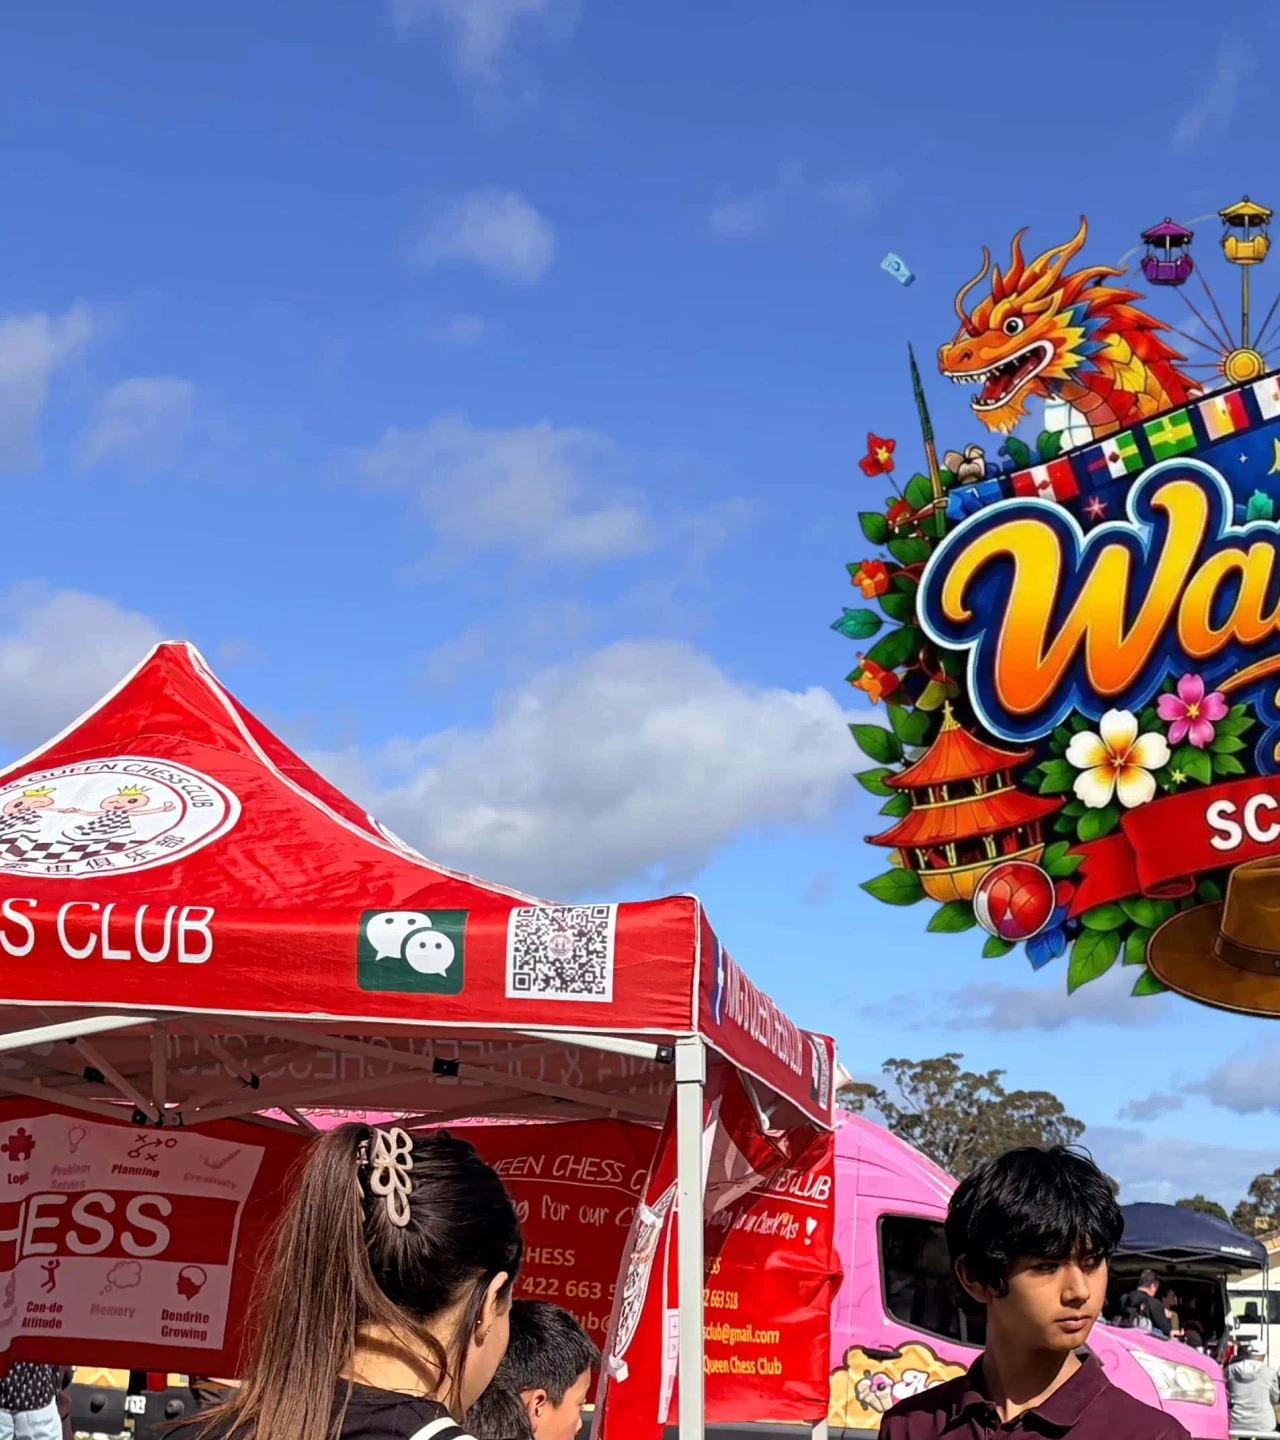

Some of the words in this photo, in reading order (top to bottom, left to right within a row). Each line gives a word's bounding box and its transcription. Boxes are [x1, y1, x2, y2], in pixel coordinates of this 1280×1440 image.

[122, 763, 191, 785] CHESS
[180, 784, 215, 809] CLUB
[56, 900, 216, 965] CLUB
[111, 1163, 161, 1179] Planning
[552, 1154, 626, 1183] CHESS
[541, 1194, 570, 1222] for
[578, 1205, 610, 1227] our
[523, 1246, 576, 1267] HESS
[521, 1275, 560, 1295] 422
[565, 1279, 602, 1299] 663
[26, 1301, 64, 1313] Can-do
[710, 1289, 725, 1309] 663
[725, 1290, 739, 1310] 518
[89, 1303, 136, 1318] Memory
[160, 1308, 210, 1324] Dendrite
[21, 1316, 63, 1329] Attitude
[160, 1325, 208, 1341] Growing
[703, 1354, 730, 1375] Queen
[730, 1355, 756, 1375] Chess
[757, 1356, 783, 1376] Club
